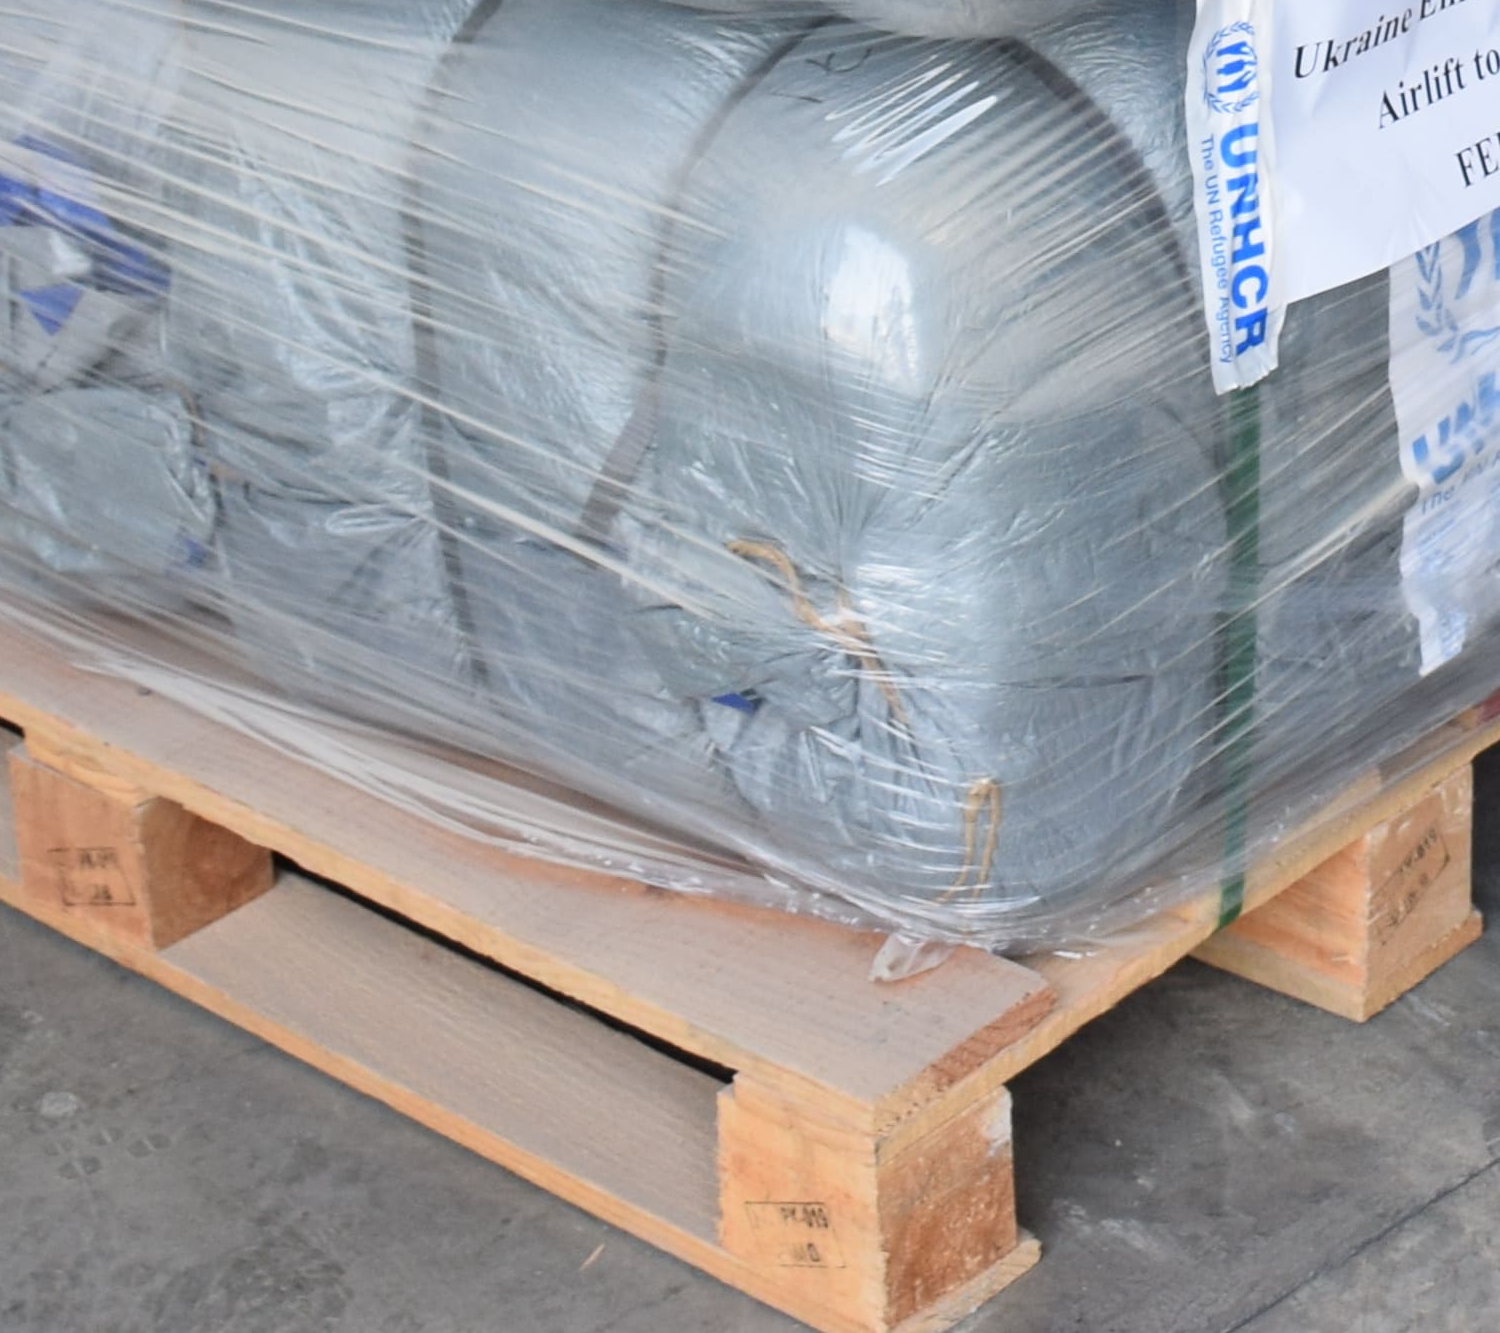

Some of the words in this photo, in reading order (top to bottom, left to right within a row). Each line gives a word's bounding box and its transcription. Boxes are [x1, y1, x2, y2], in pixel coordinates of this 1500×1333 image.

[1292, 4, 1414, 81] Ukraine
[1376, 57, 1468, 131] Airlift
[1199, 134, 1215, 174] The
[1204, 175, 1221, 207] UN
[1207, 209, 1229, 290] Refugee
[1219, 120, 1270, 359] UNHCR
